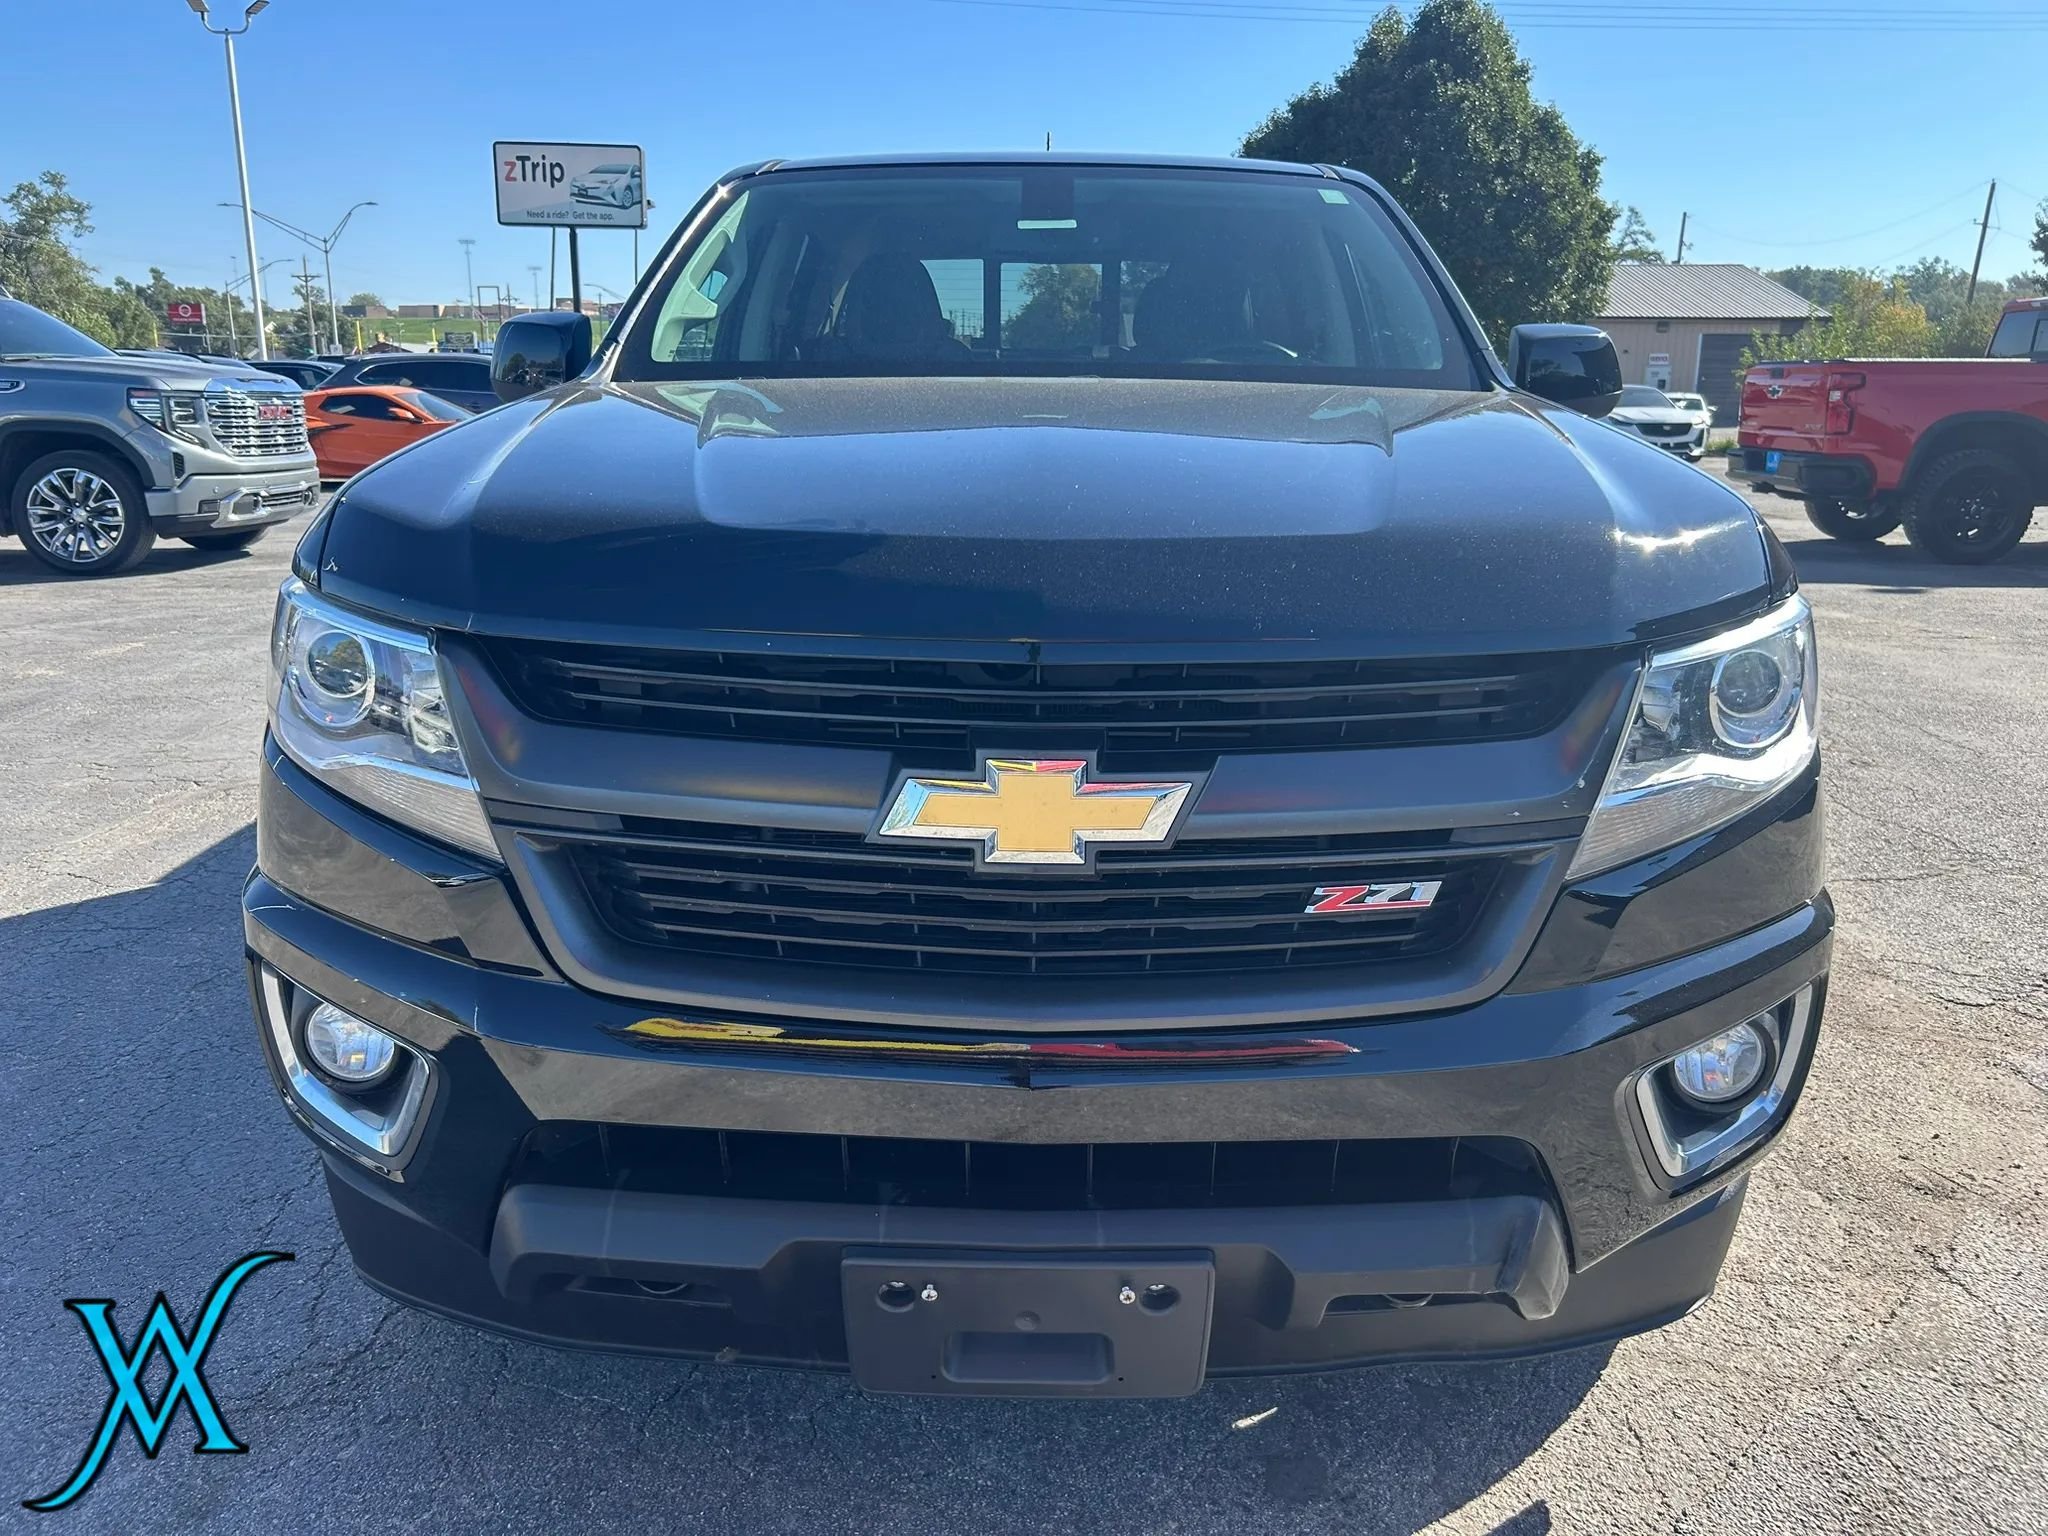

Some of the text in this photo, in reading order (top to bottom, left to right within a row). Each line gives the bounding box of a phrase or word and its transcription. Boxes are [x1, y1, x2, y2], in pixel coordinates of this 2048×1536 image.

[504, 154, 565, 188] zTrip
[526, 210, 545, 218] Need
[552, 210, 569, 219] ride?
[572, 210, 586, 219] Get
[586, 211, 598, 220] the
[599, 212, 615, 221] app.
[1304, 881, 1442, 913] Z71
